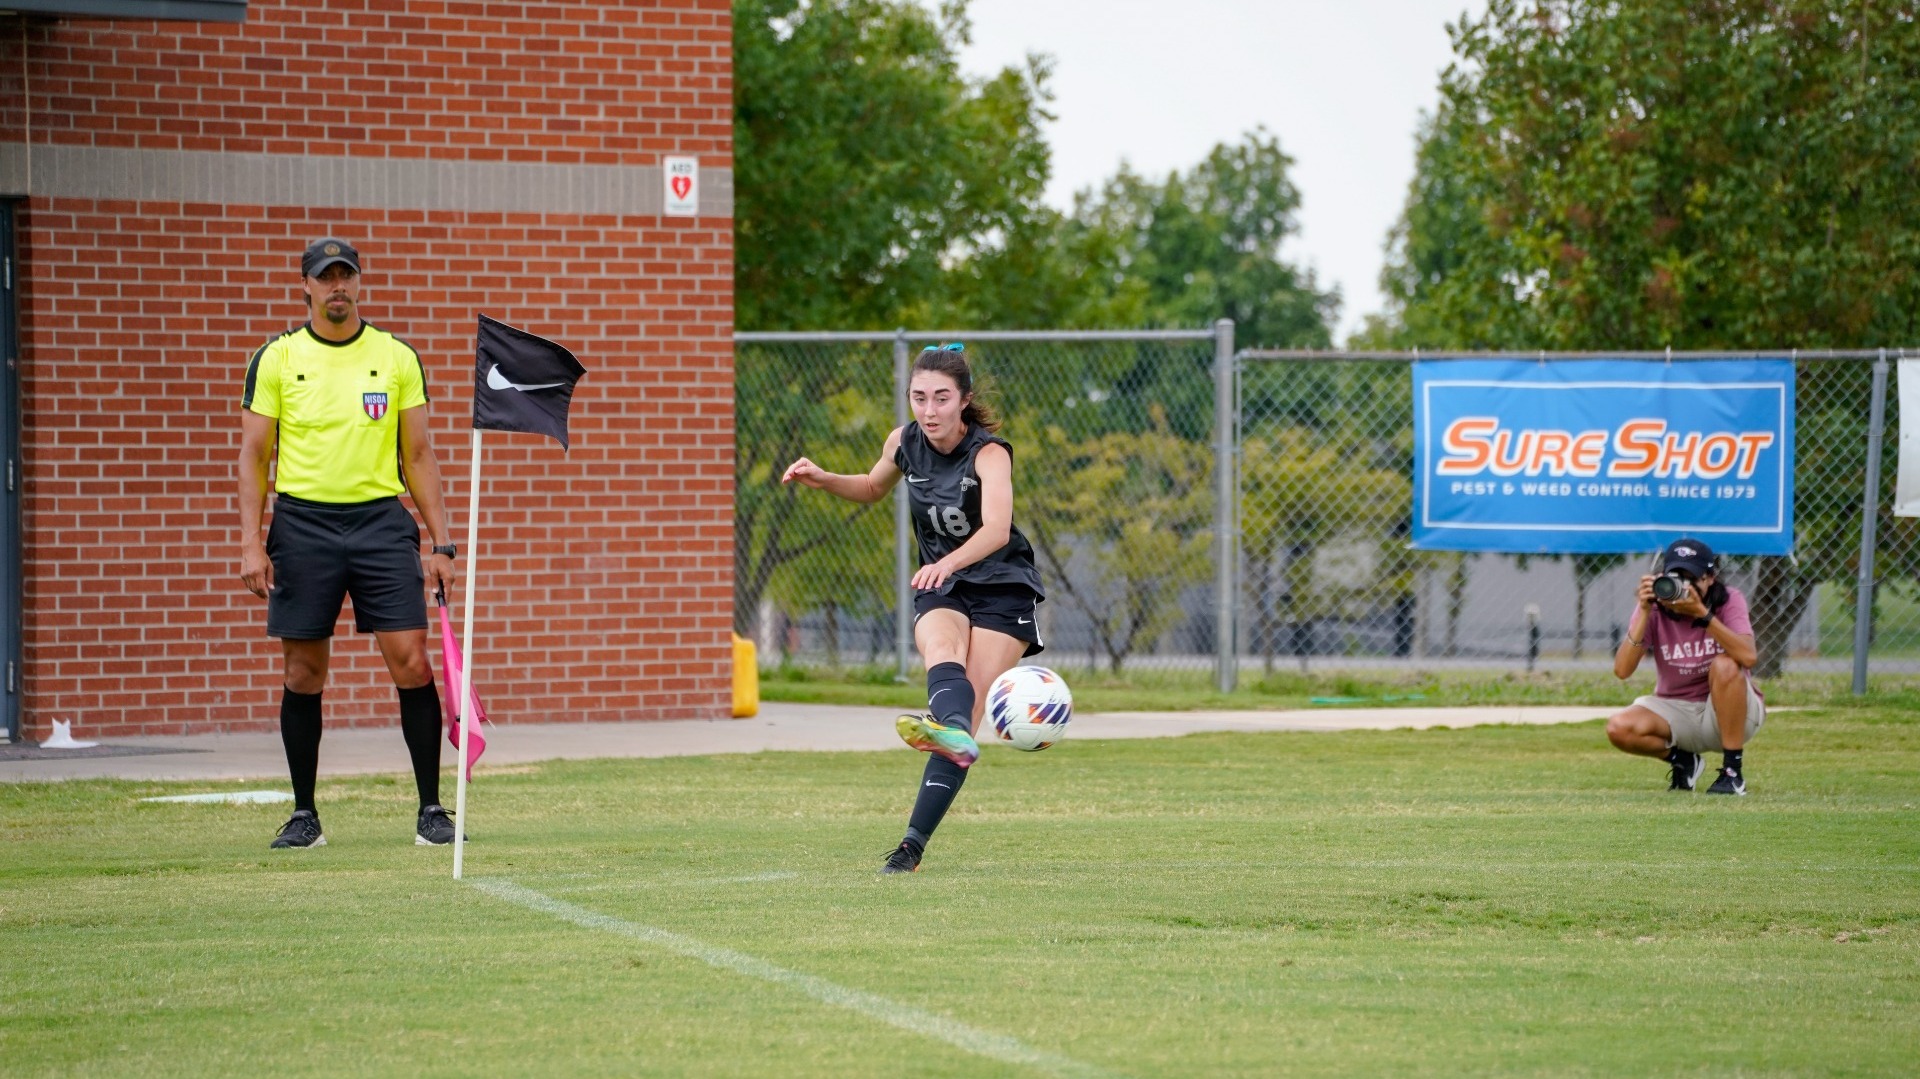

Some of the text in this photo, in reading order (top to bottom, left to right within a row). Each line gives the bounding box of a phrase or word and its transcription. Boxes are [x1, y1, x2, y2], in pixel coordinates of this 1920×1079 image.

[671, 163, 692, 173] AED
[364, 394, 387, 404] NISOA
[1435, 415, 1775, 480] SURE SHOT
[1451, 482, 1756, 499] PEST & WEED CONTROL SINCE 1973
[927, 505, 972, 537] 18
